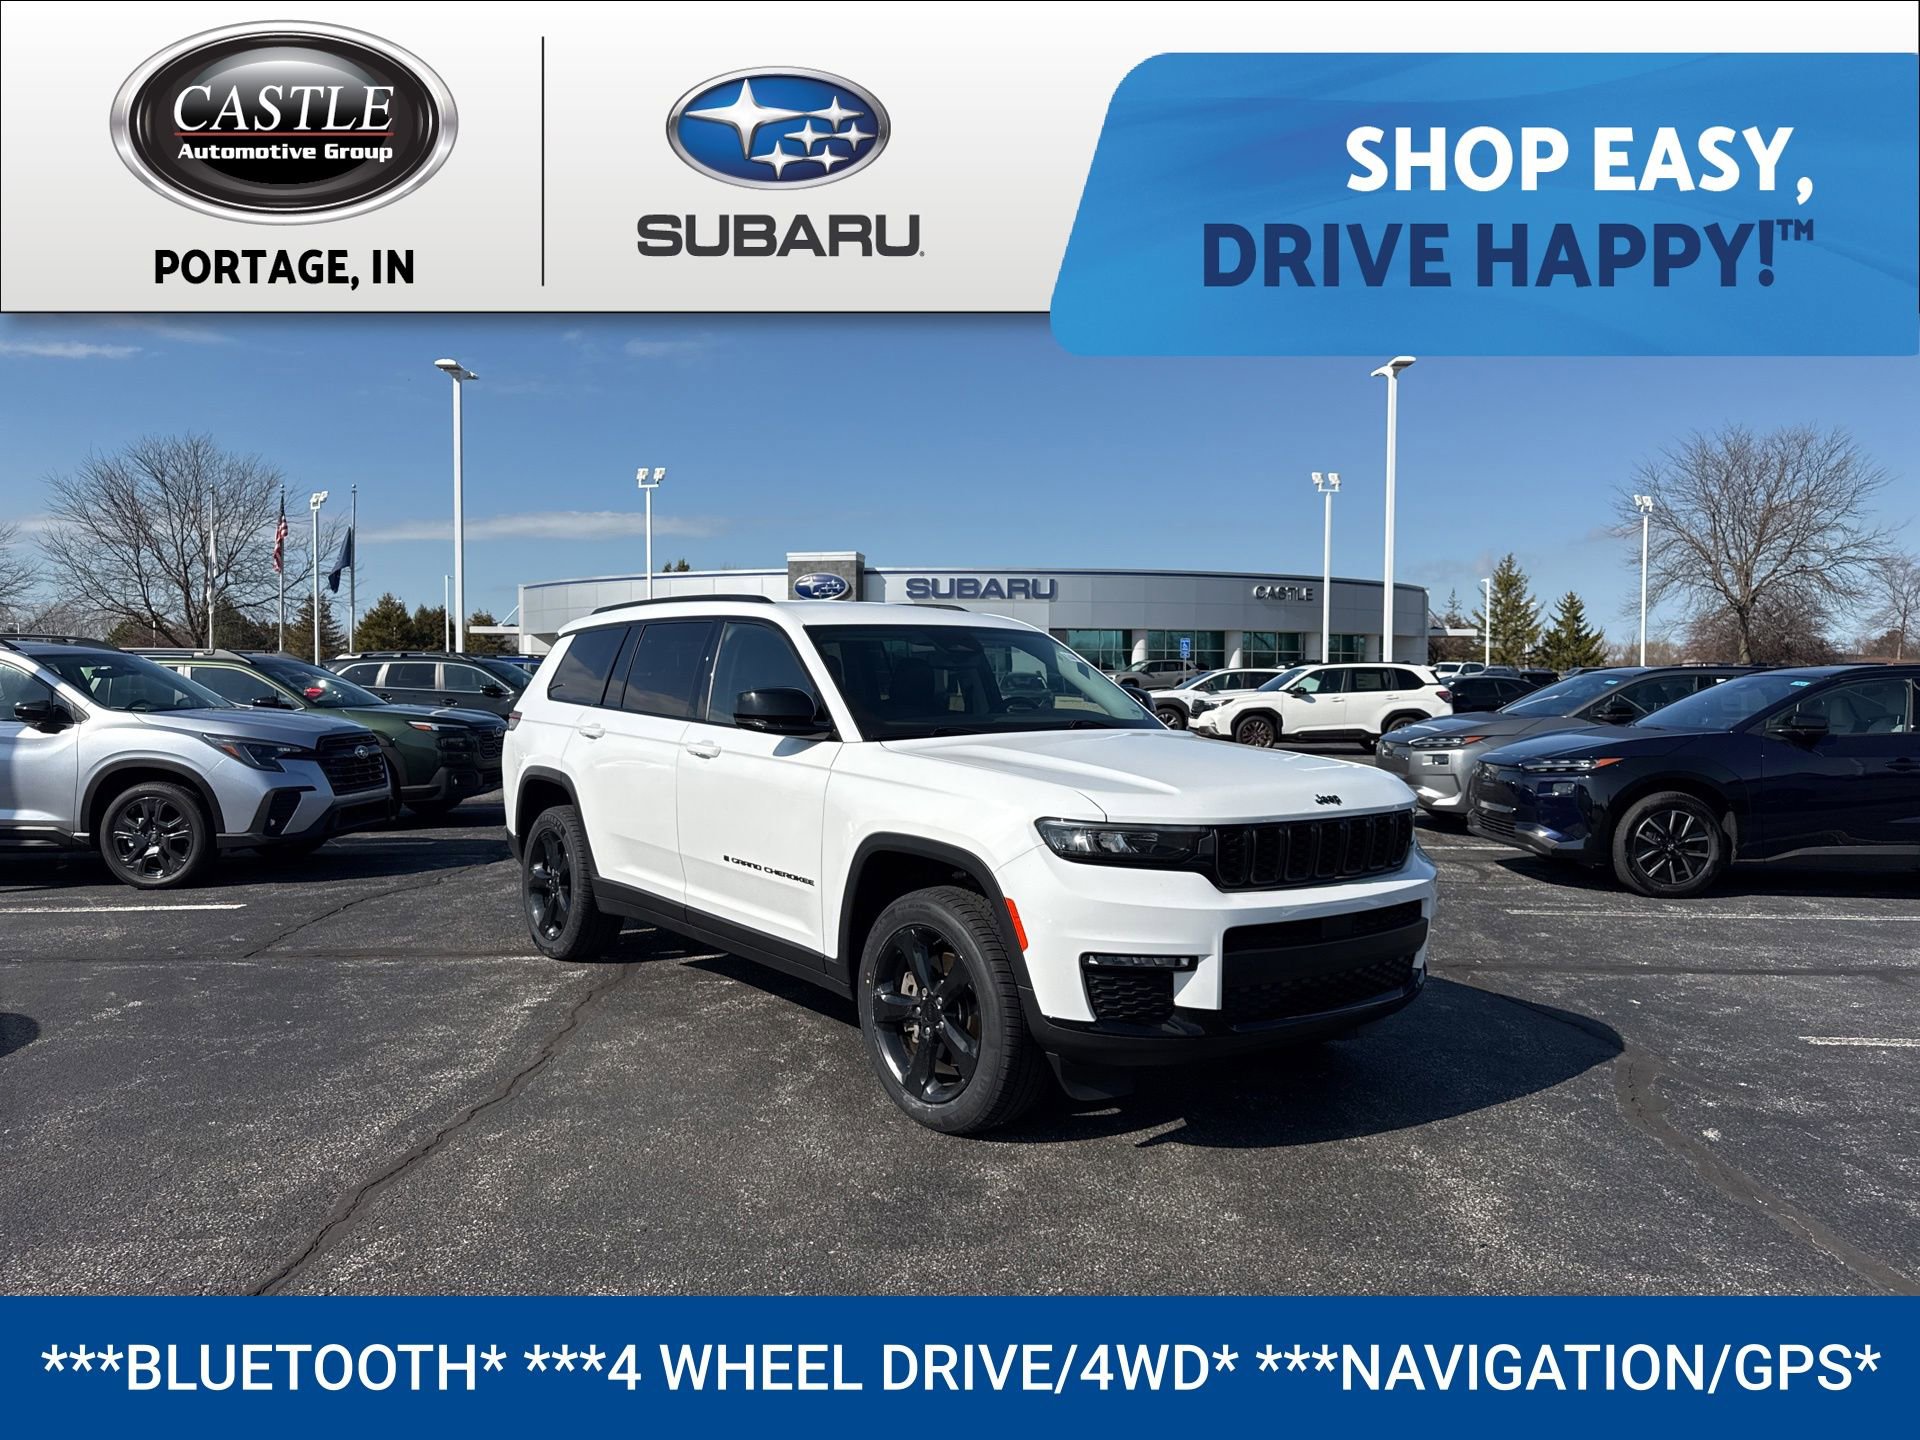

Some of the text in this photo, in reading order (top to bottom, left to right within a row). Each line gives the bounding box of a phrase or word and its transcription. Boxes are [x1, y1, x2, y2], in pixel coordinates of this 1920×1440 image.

[905, 577, 1056, 600] SUBARU
[1253, 585, 1314, 602] CASTLE
[1315, 793, 1342, 806] Jeep
[731, 857, 815, 887] GRAND CHEROKEE
